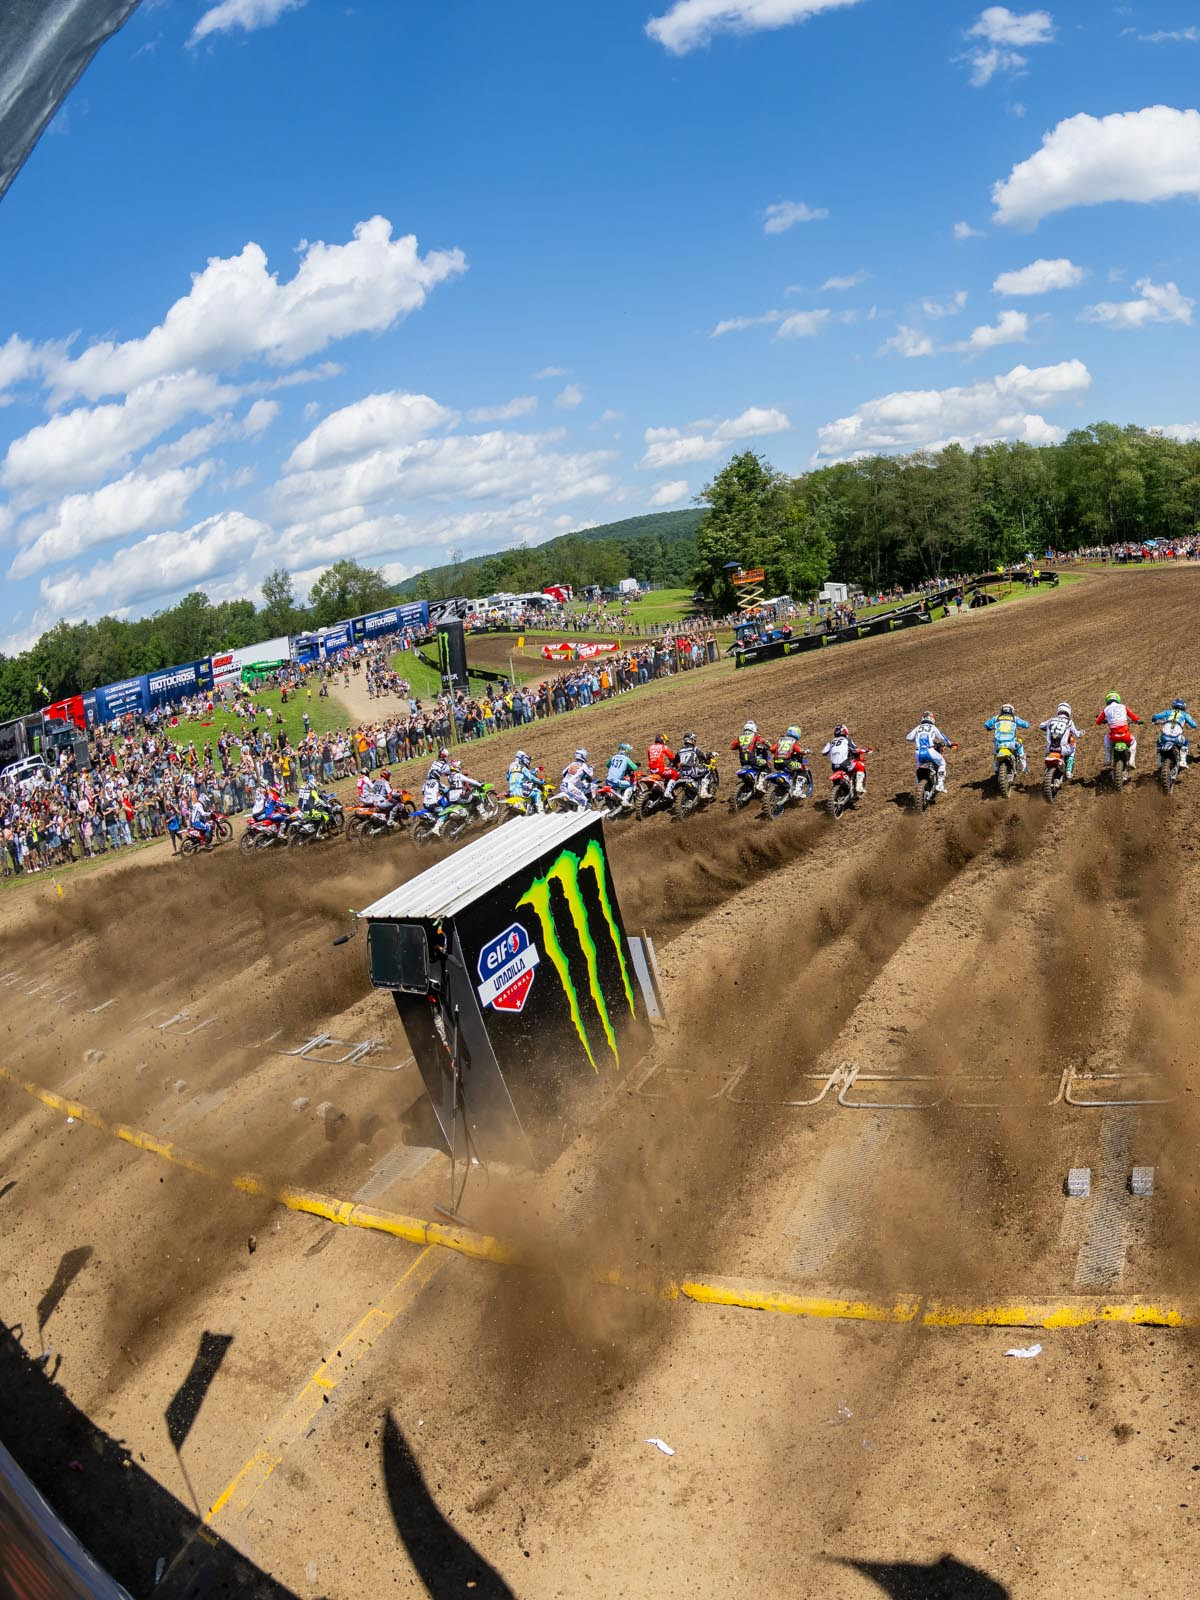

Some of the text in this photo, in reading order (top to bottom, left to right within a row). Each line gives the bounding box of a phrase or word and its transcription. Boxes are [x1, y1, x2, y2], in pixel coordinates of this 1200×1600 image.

[149, 670, 196, 691] MOTOCROSS
[917, 725, 932, 733] 53
[1050, 721, 1066, 734] 79
[739, 735, 751, 745] 93
[779, 740, 793, 751] 75
[487, 940, 507, 970] elf
[493, 958, 526, 991] UNADILLA
[498, 975, 530, 1003] NATIONAL
